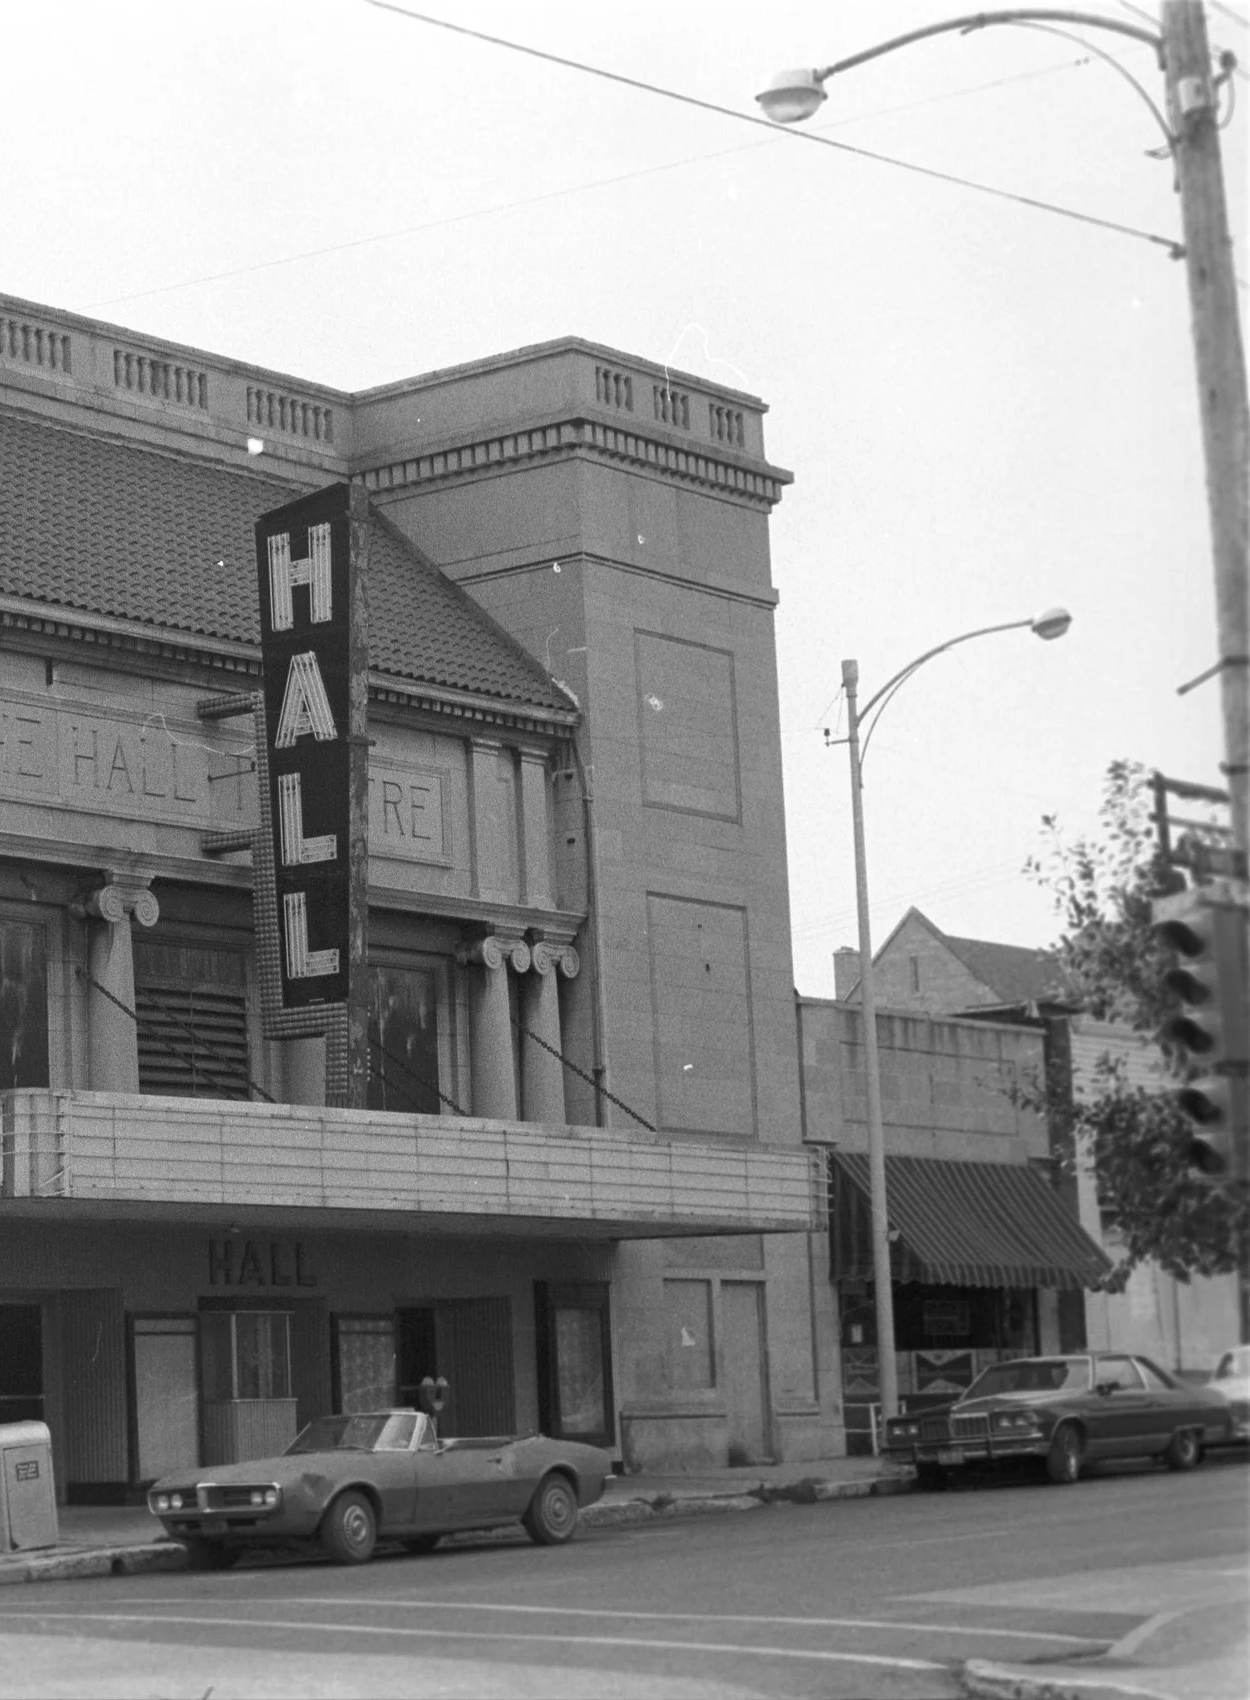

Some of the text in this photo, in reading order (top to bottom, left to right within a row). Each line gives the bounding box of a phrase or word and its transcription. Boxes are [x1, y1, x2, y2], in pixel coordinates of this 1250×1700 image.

[71, 726, 197, 803] HALL
[267, 522, 340, 978] HALL
[208, 1238, 318, 1287] HALL
